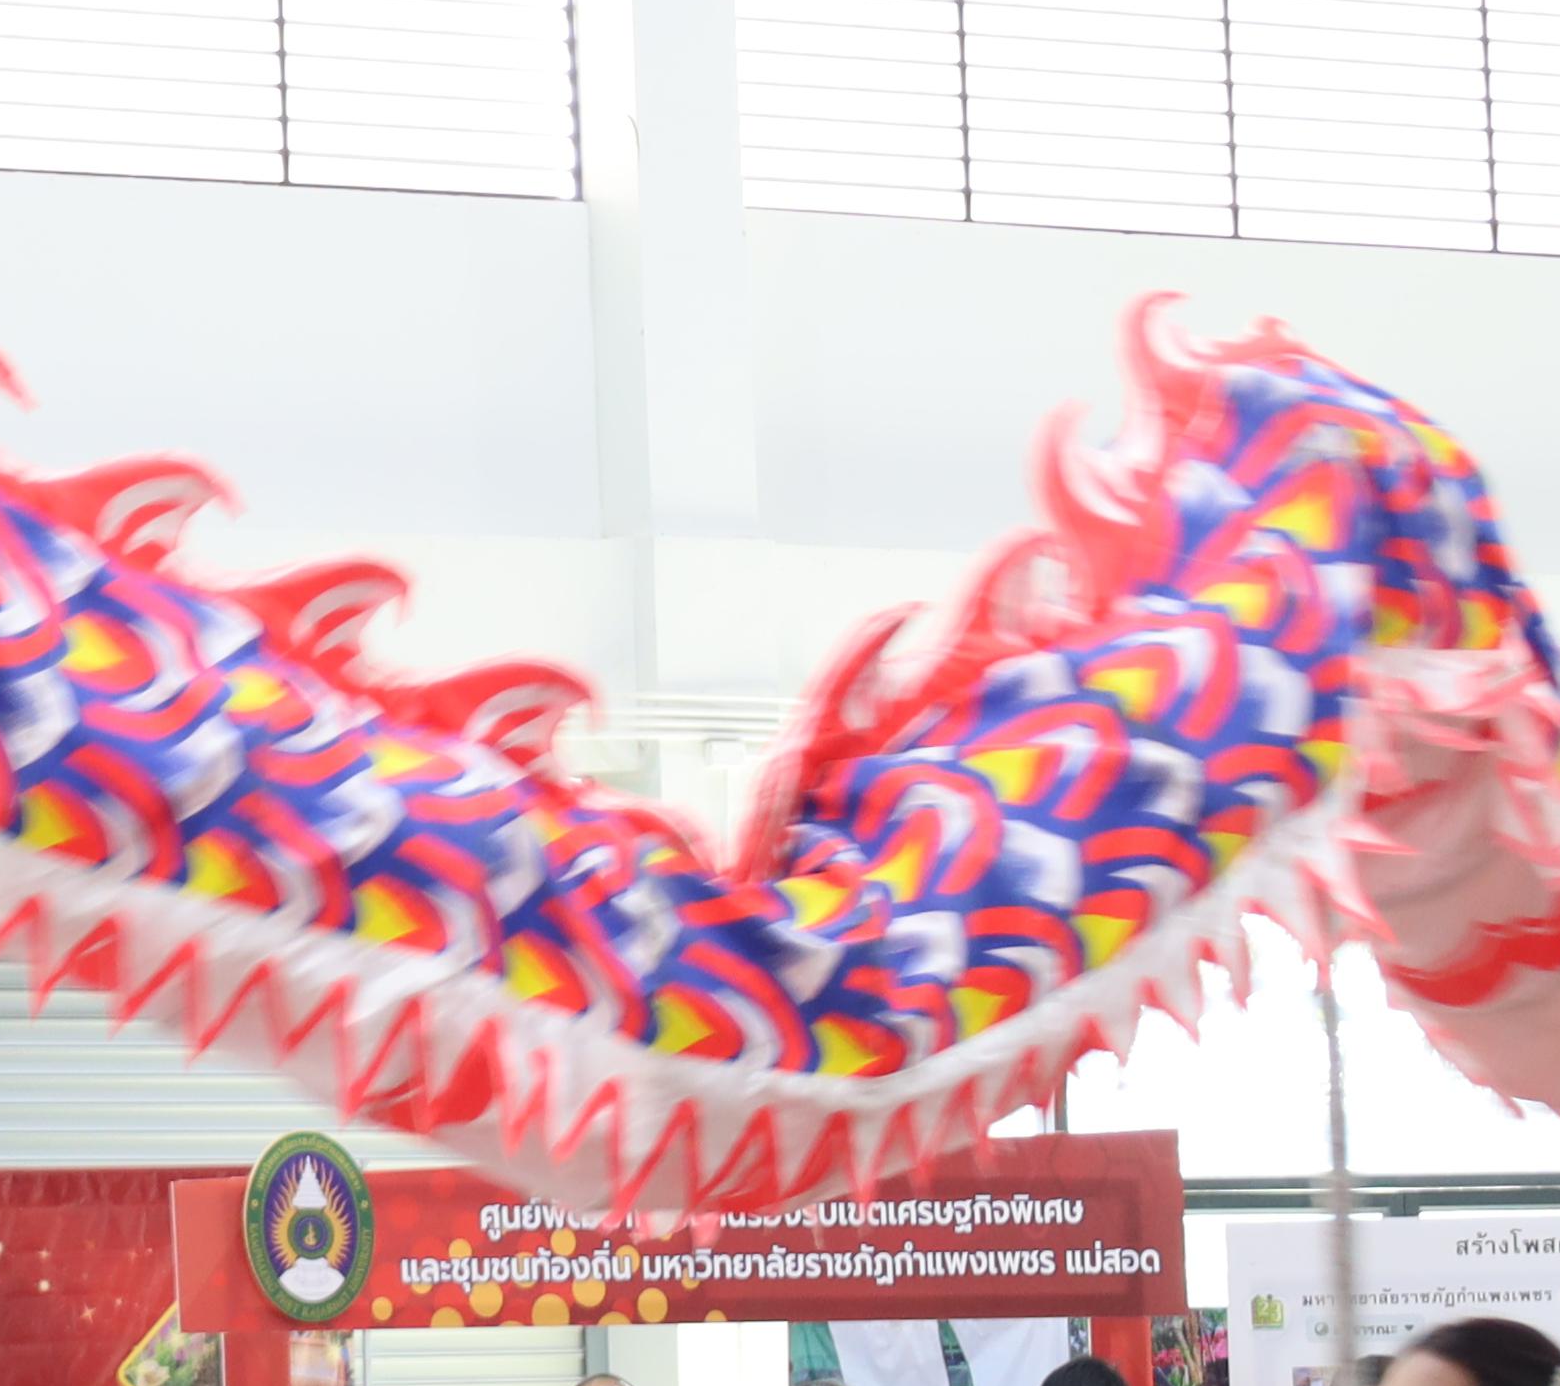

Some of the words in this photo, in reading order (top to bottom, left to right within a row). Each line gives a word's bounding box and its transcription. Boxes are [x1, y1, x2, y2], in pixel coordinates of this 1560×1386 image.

[400, 1240, 632, 1292] และชุมชนท้องถิ่น
[642, 1241, 1056, 1285] มหาวิทยาลัยราชภัฏกำแพงเพชร
[1066, 1240, 1161, 1274] แม่สอด
